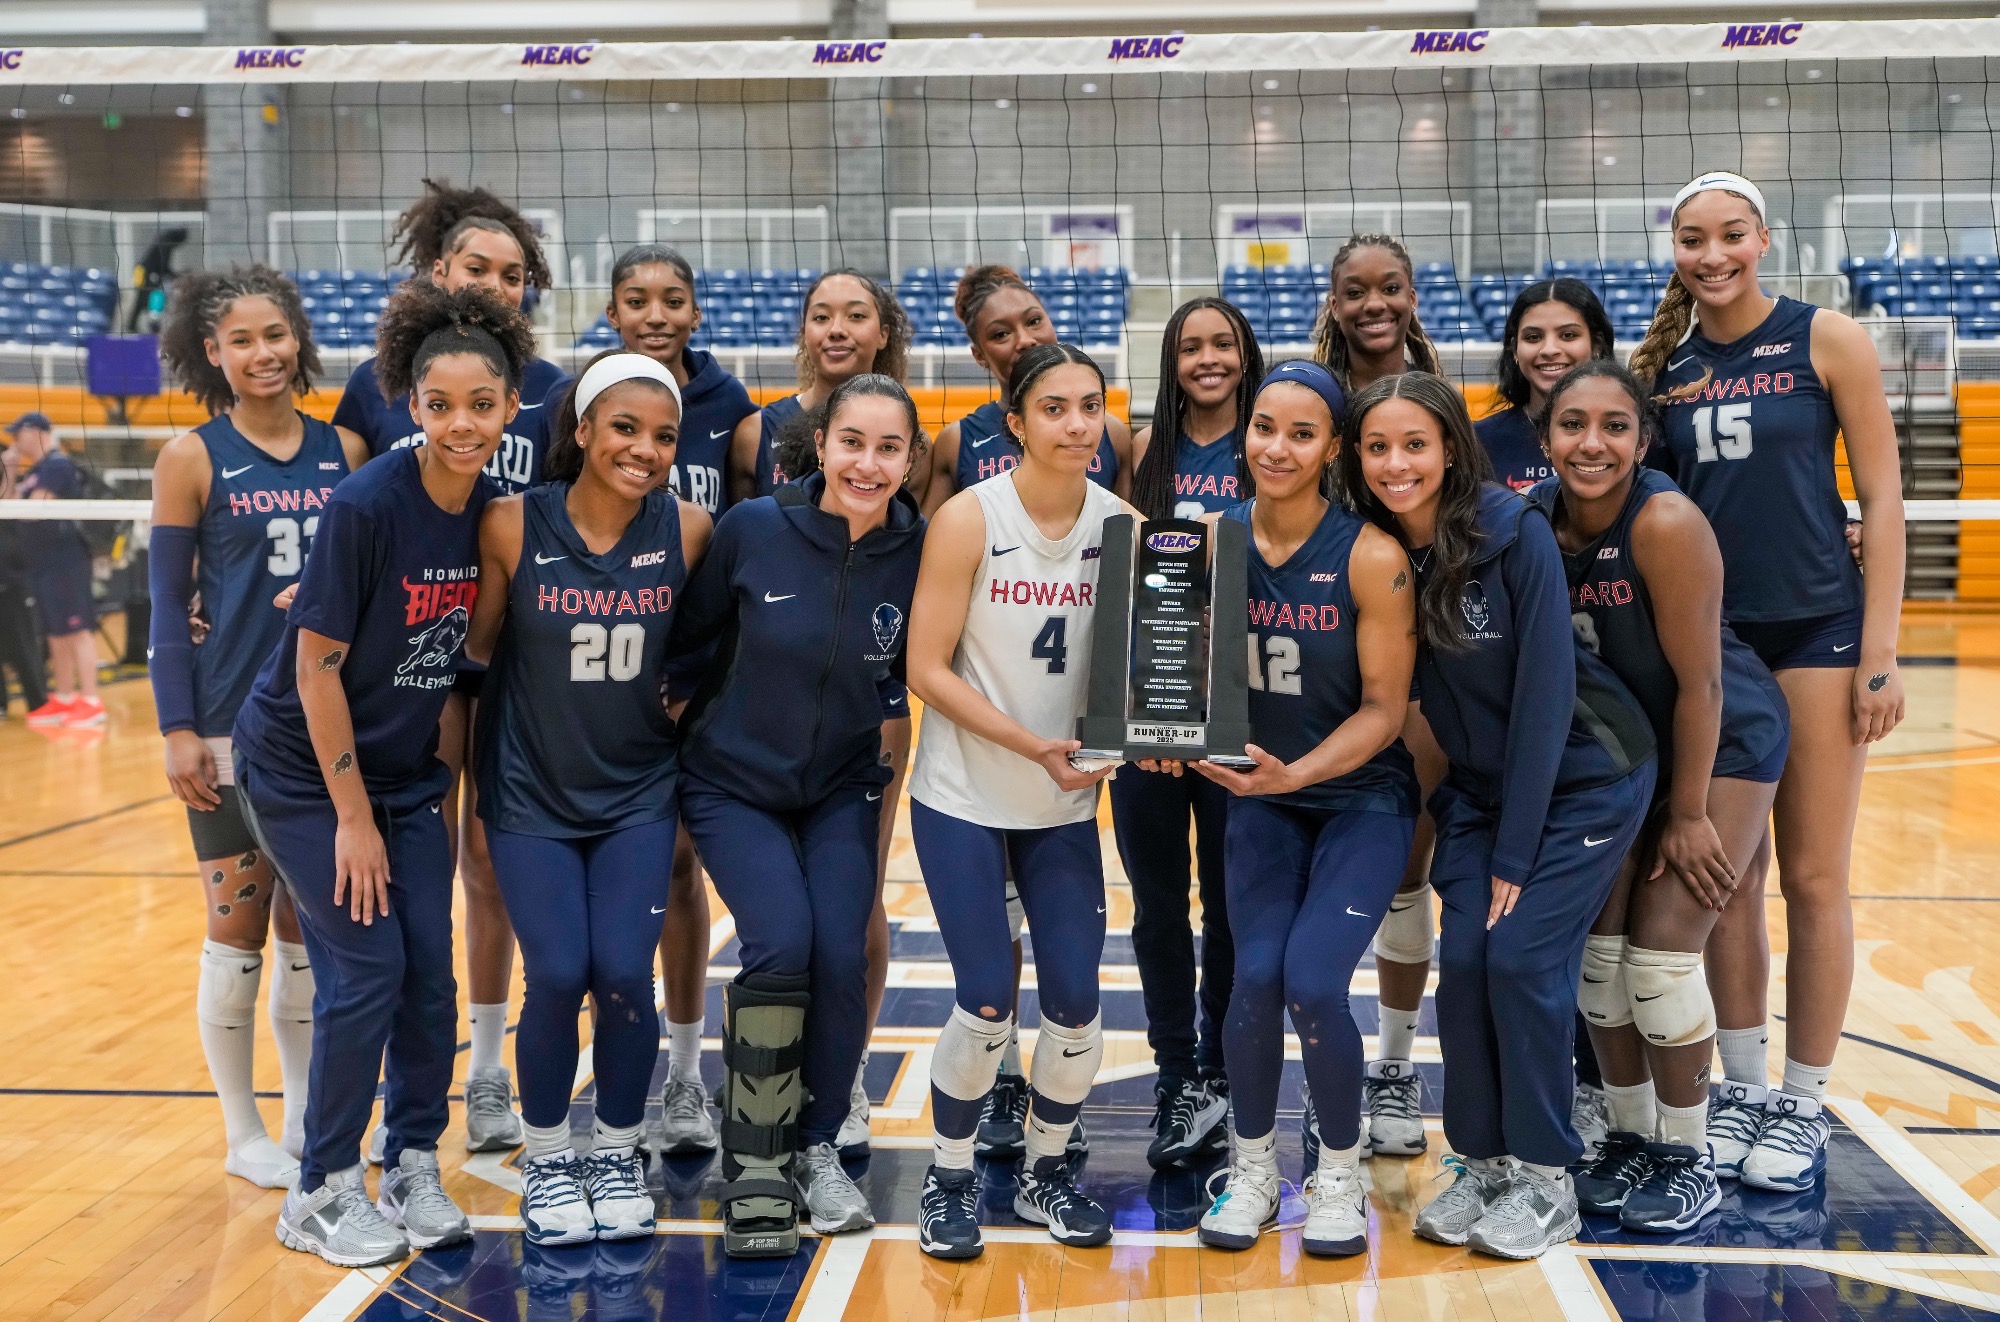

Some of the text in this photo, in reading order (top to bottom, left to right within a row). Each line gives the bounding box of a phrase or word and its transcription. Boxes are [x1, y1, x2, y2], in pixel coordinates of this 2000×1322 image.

[1107, 37, 1184, 63] MEAC
[1410, 30, 1489, 55] MEAC
[1721, 23, 1803, 51] MEAC
[234, 48, 305, 72] MEAC
[522, 45, 594, 68] MEAC
[813, 42, 886, 68] MEAC
[1752, 342, 1792, 358] MEAC
[1692, 402, 1753, 463] 15
[1150, 534, 1201, 549] MEAC
[631, 550, 666, 569] MEAC
[1310, 573, 1337, 583] MEAC
[538, 585, 672, 616] HOWARD
[990, 579, 1099, 607] HOWAR
[570, 623, 645, 682] 20
[1030, 615, 1068, 676] 4
[1247, 632, 1302, 696] 12
[1134, 728, 1198, 738] RUNNER-UP
